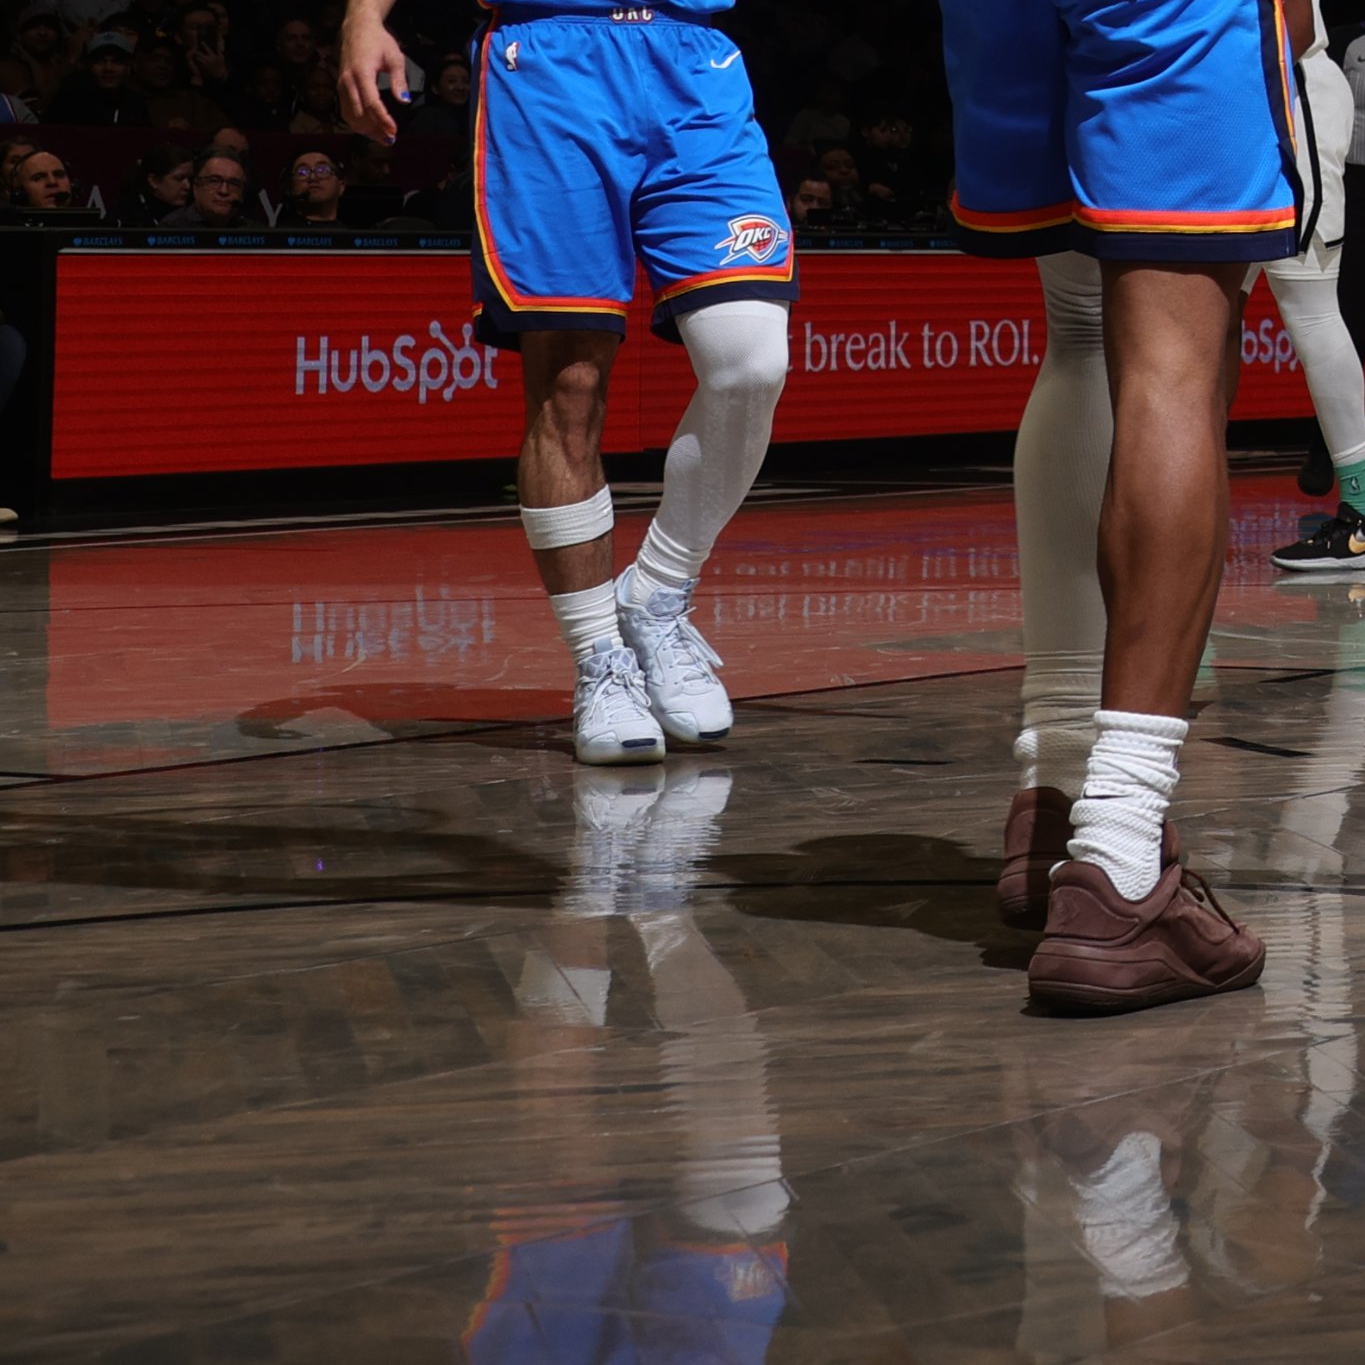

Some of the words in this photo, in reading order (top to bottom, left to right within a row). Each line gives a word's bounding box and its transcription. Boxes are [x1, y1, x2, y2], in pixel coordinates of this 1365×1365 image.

[296, 321, 499, 404] HubSpot
[804, 319, 912, 373] break
[921, 322, 959, 370] to
[968, 318, 1040, 368] ROI.
